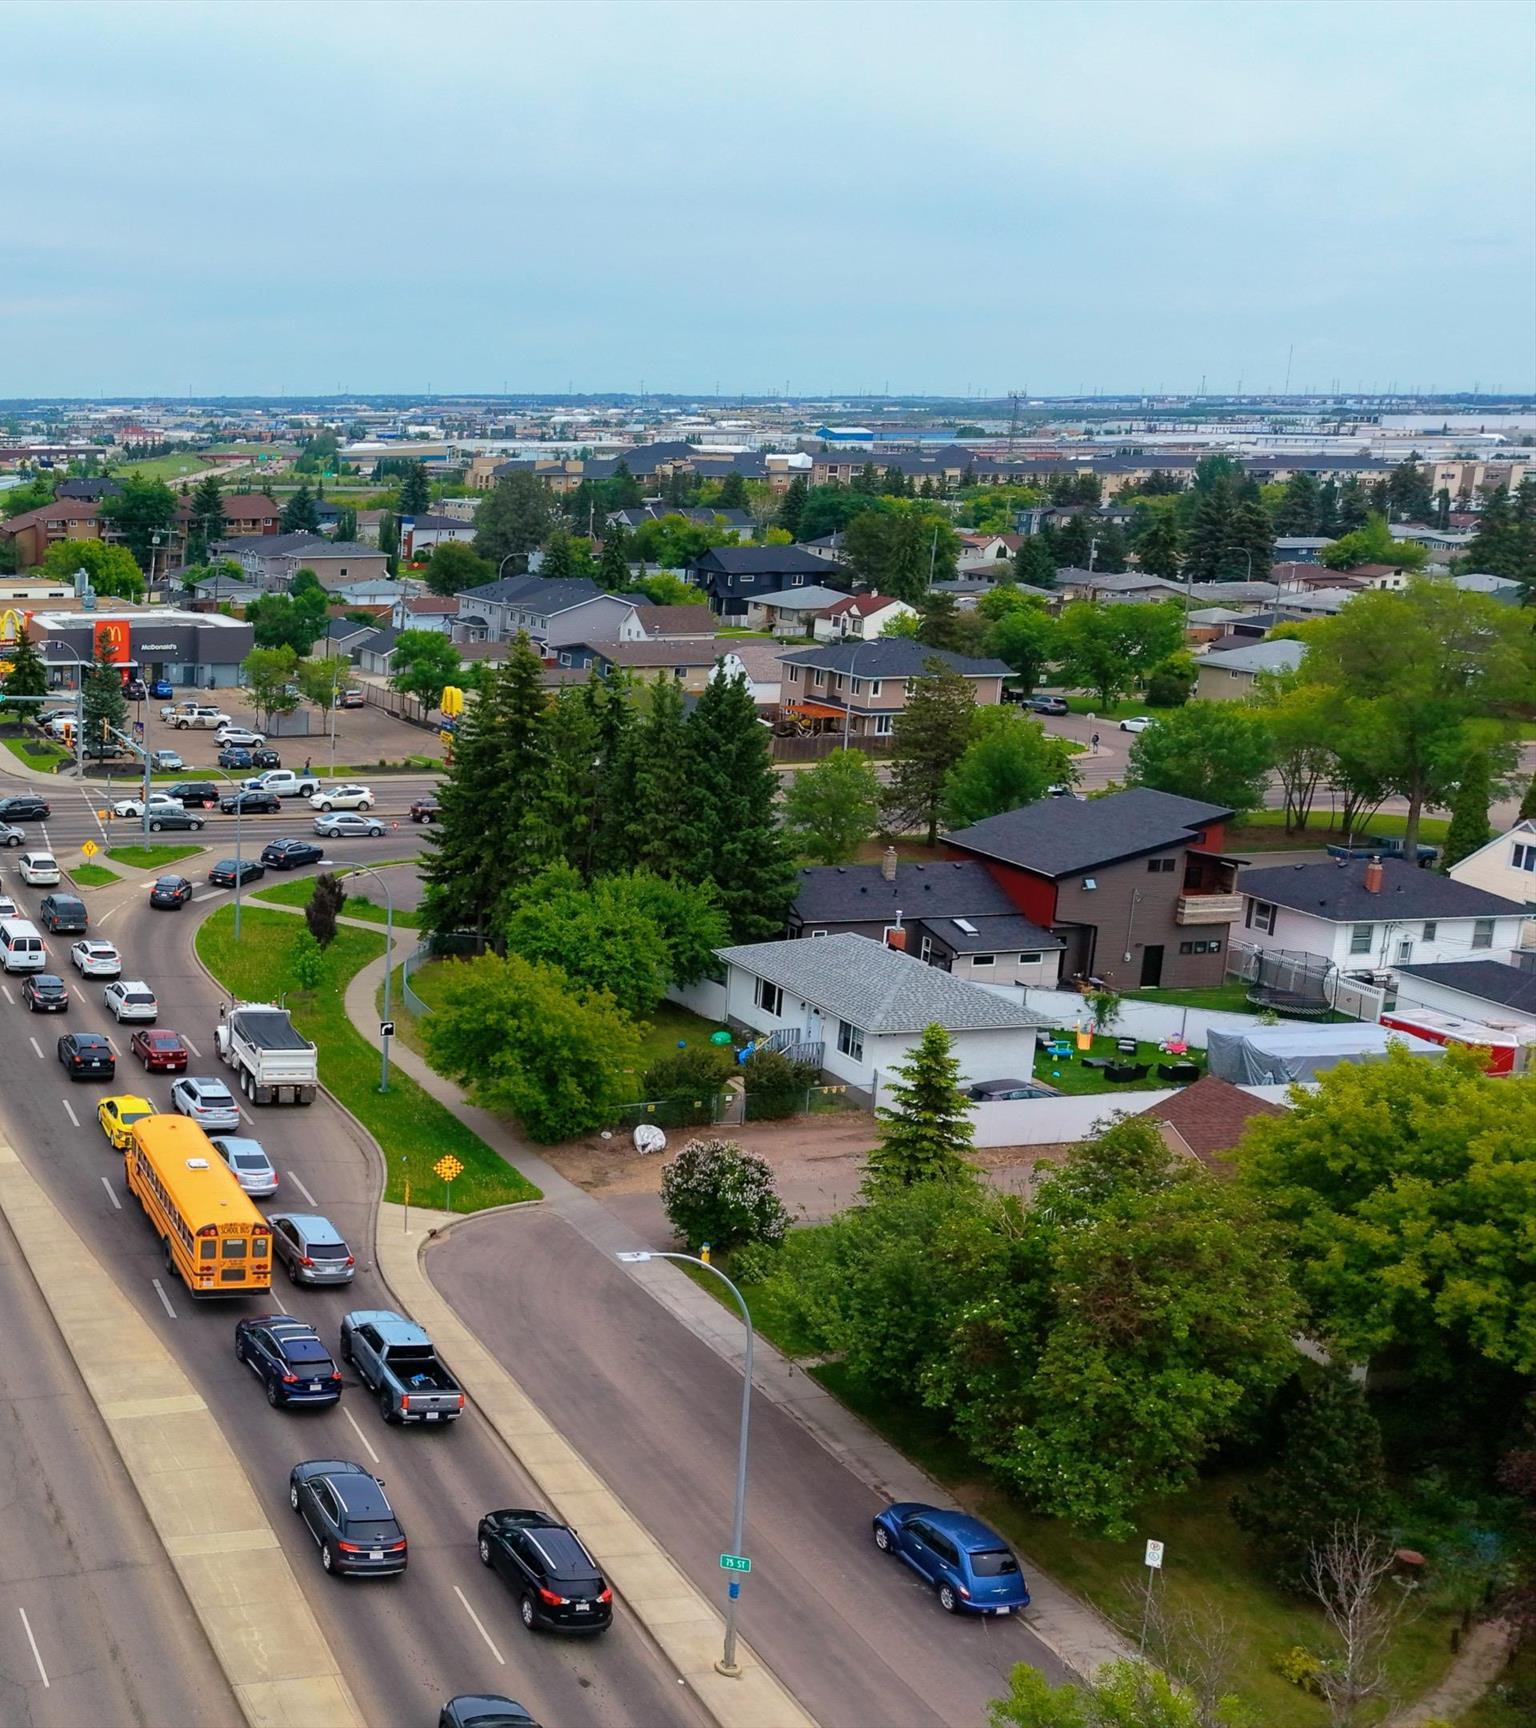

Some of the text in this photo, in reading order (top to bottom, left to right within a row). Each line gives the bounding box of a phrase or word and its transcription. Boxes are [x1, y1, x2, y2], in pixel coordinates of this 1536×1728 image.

[141, 643, 177, 651] McDonald's
[726, 1558, 746, 1569] 75 ST
